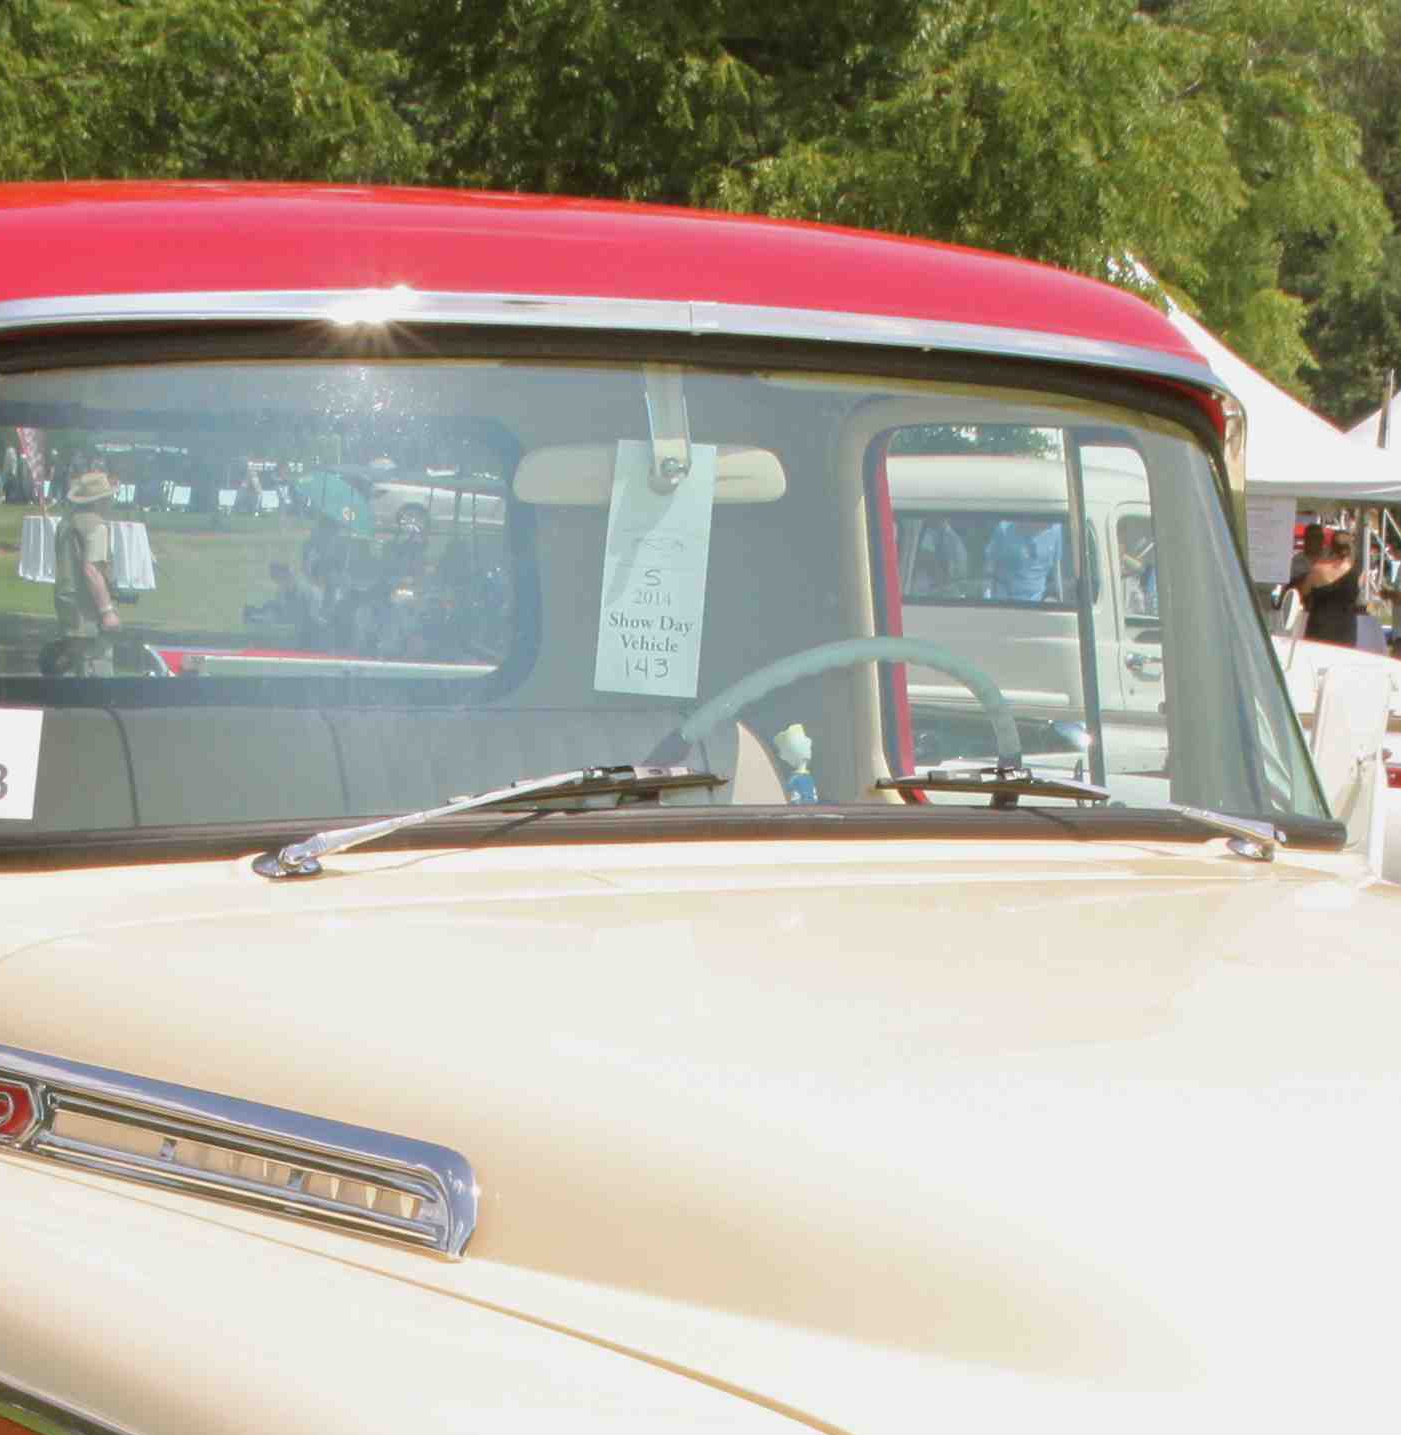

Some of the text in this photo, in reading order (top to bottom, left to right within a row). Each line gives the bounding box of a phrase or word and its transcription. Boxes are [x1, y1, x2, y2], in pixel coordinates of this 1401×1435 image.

[644, 568, 663, 588] S
[632, 591, 672, 607] 2014
[608, 611, 694, 637] Show Day
[621, 634, 679, 653] Vehicle
[625, 656, 670, 680] 143
